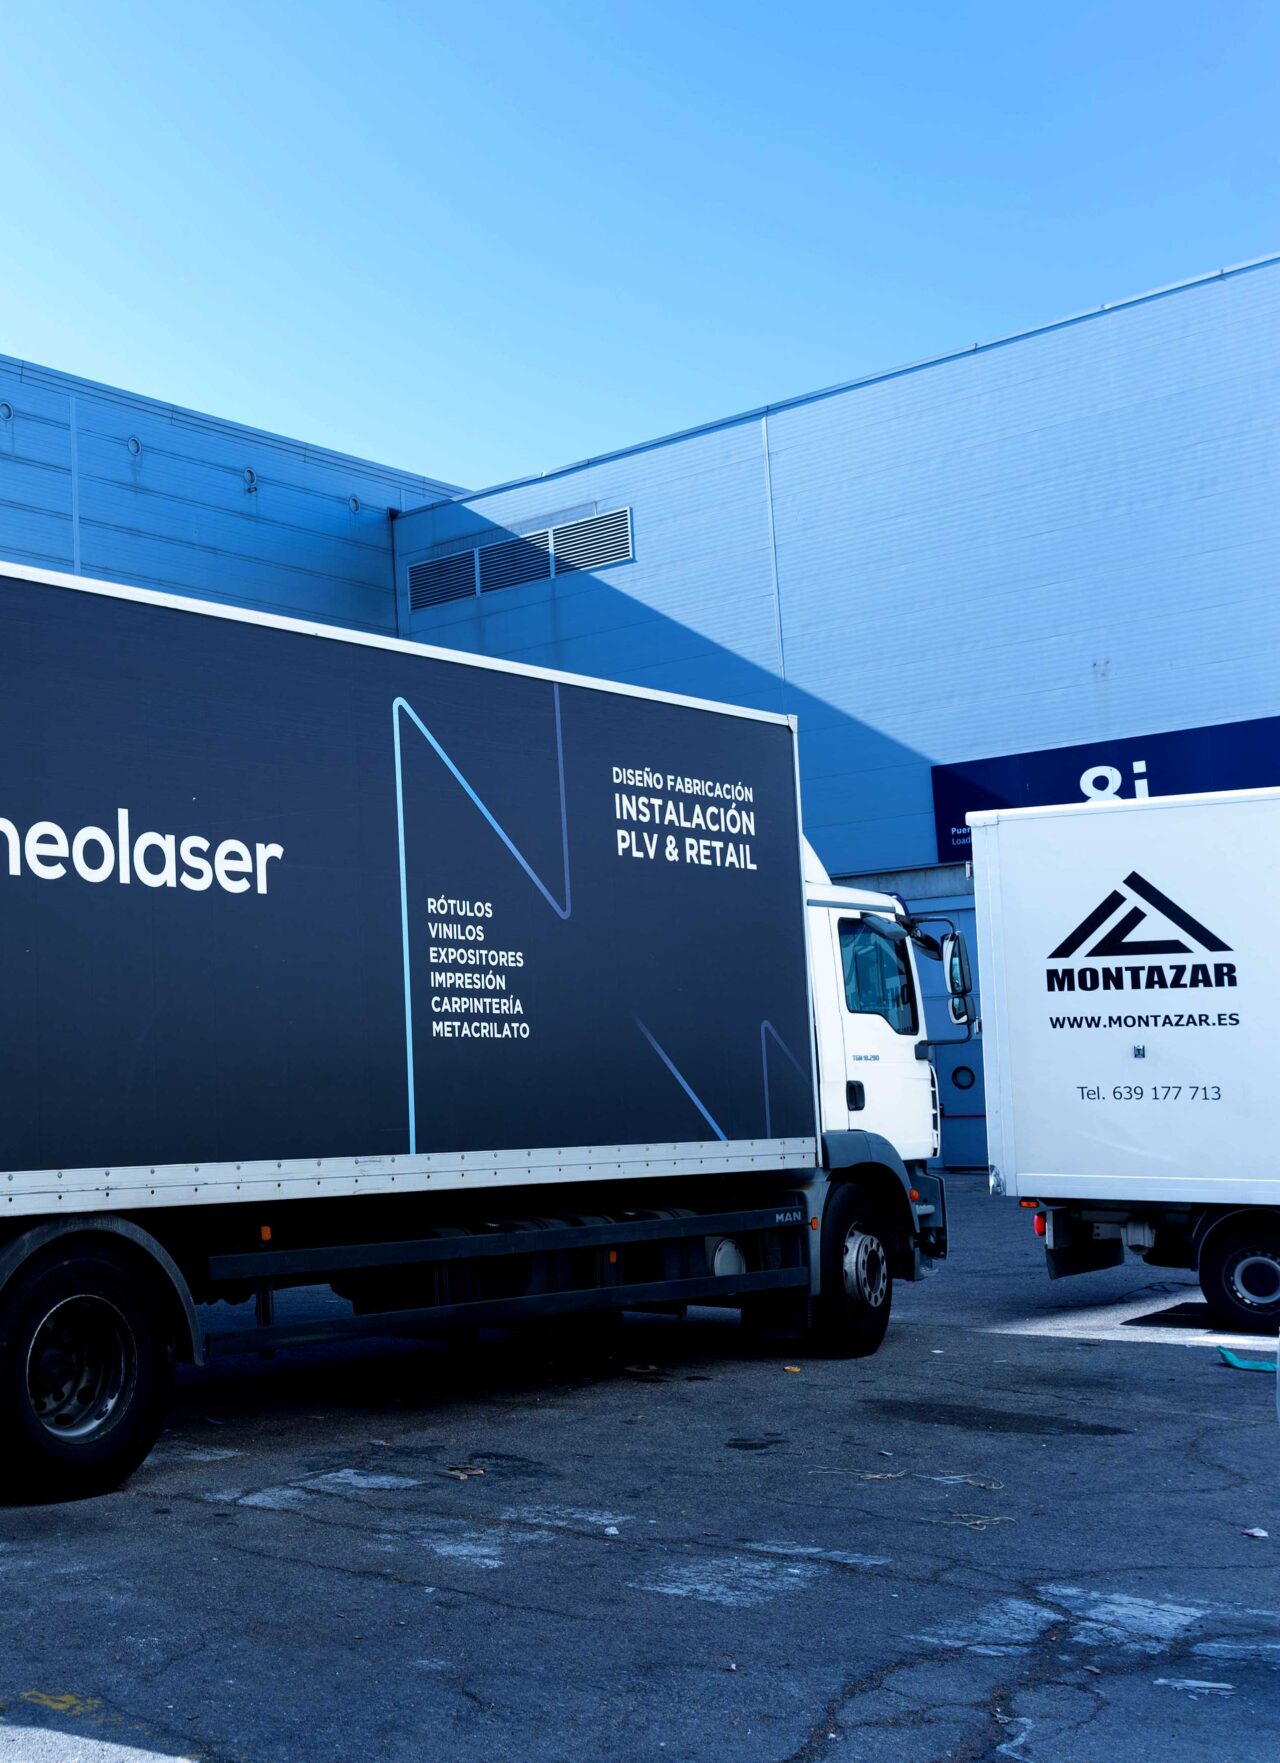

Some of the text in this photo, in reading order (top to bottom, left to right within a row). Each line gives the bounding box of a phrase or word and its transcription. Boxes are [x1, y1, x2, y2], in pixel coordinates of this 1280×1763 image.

[612, 766, 754, 803] DISEÑO FABRICACIÓN
[614, 792, 756, 837] INSTALACIÓN
[950, 826, 971, 836] Puer
[951, 835, 972, 846] Load
[616, 829, 758, 870] PLV & RETAIL
[427, 894, 493, 918] RÓTULOS
[427, 921, 485, 942] VINILOS
[429, 946, 524, 967] EXPOSITORES
[430, 970, 506, 990] IMPRESIÓN
[1046, 962, 1238, 992] MONTAZAR
[431, 995, 524, 1014] CARPINTERÍA
[432, 1020, 530, 1038] METACRILATO
[1049, 1012, 1241, 1029] WWW.MONTAZAR.ES
[1076, 1085, 1222, 1101] Tel. 639 177 713
[775, 1210, 801, 1223] MAN
